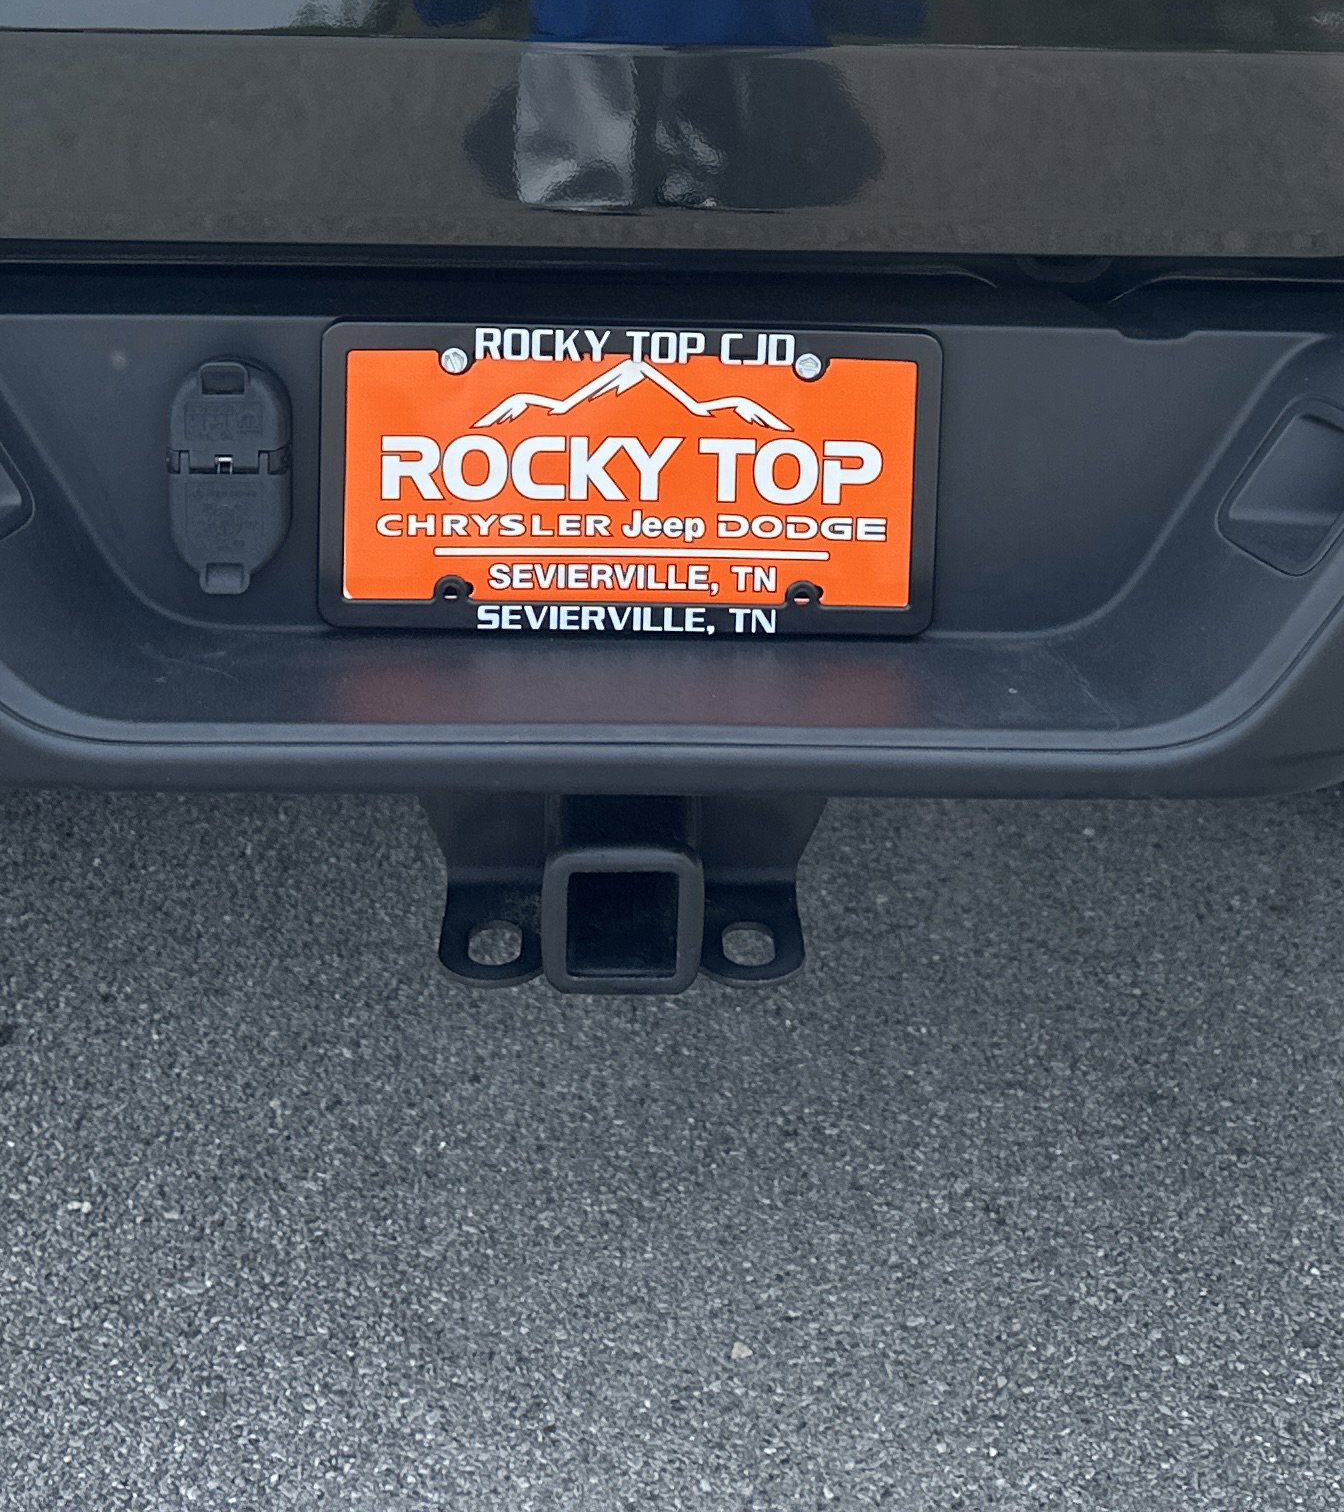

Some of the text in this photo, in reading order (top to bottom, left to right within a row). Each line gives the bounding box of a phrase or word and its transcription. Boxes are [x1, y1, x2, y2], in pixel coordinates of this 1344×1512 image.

[474, 327, 796, 366] ROCKY TOP CJD
[380, 435, 884, 505] ROCKY TOP
[376, 510, 888, 542] CHRYSLER Jeep DODGE
[487, 563, 777, 595] SEVIERVILLE, TN
[476, 605, 777, 636] SEVIERVILLE, TN
